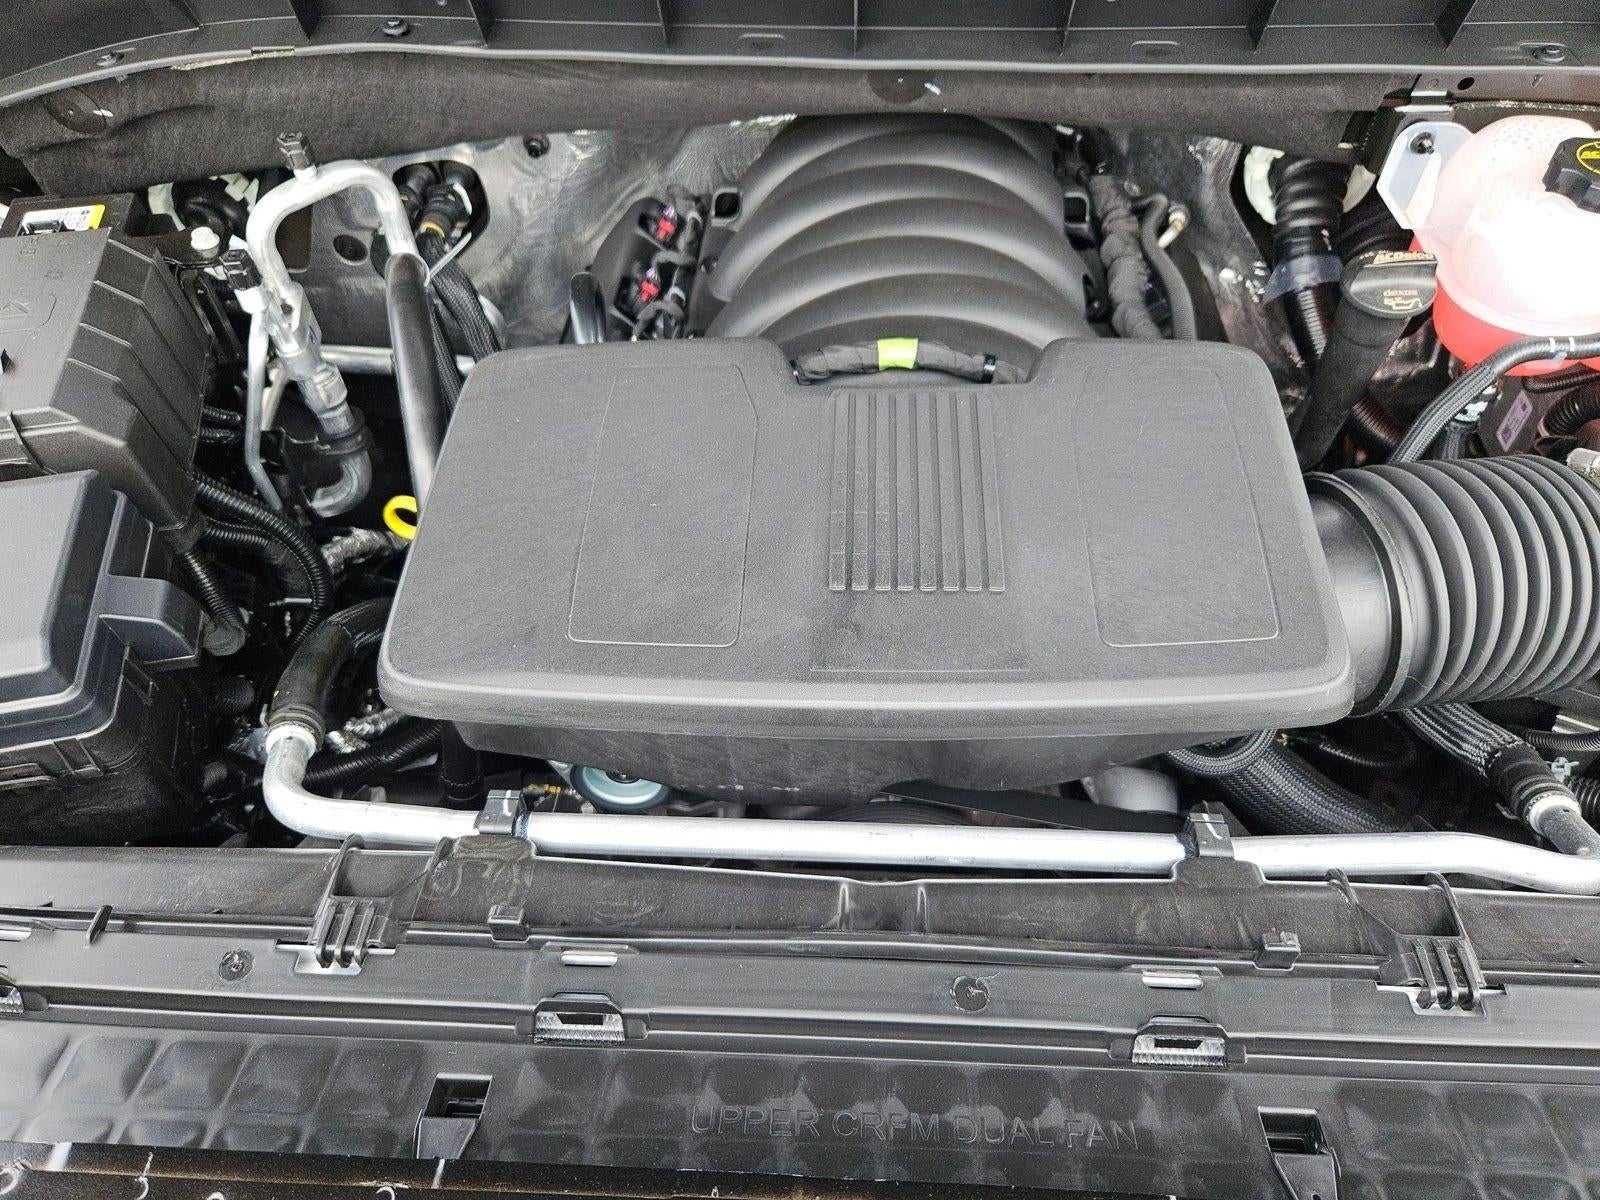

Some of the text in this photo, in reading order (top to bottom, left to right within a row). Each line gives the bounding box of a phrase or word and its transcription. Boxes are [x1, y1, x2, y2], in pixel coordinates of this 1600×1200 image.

[691, 1105, 1140, 1151] UPPER CRFM DUAL FAN
